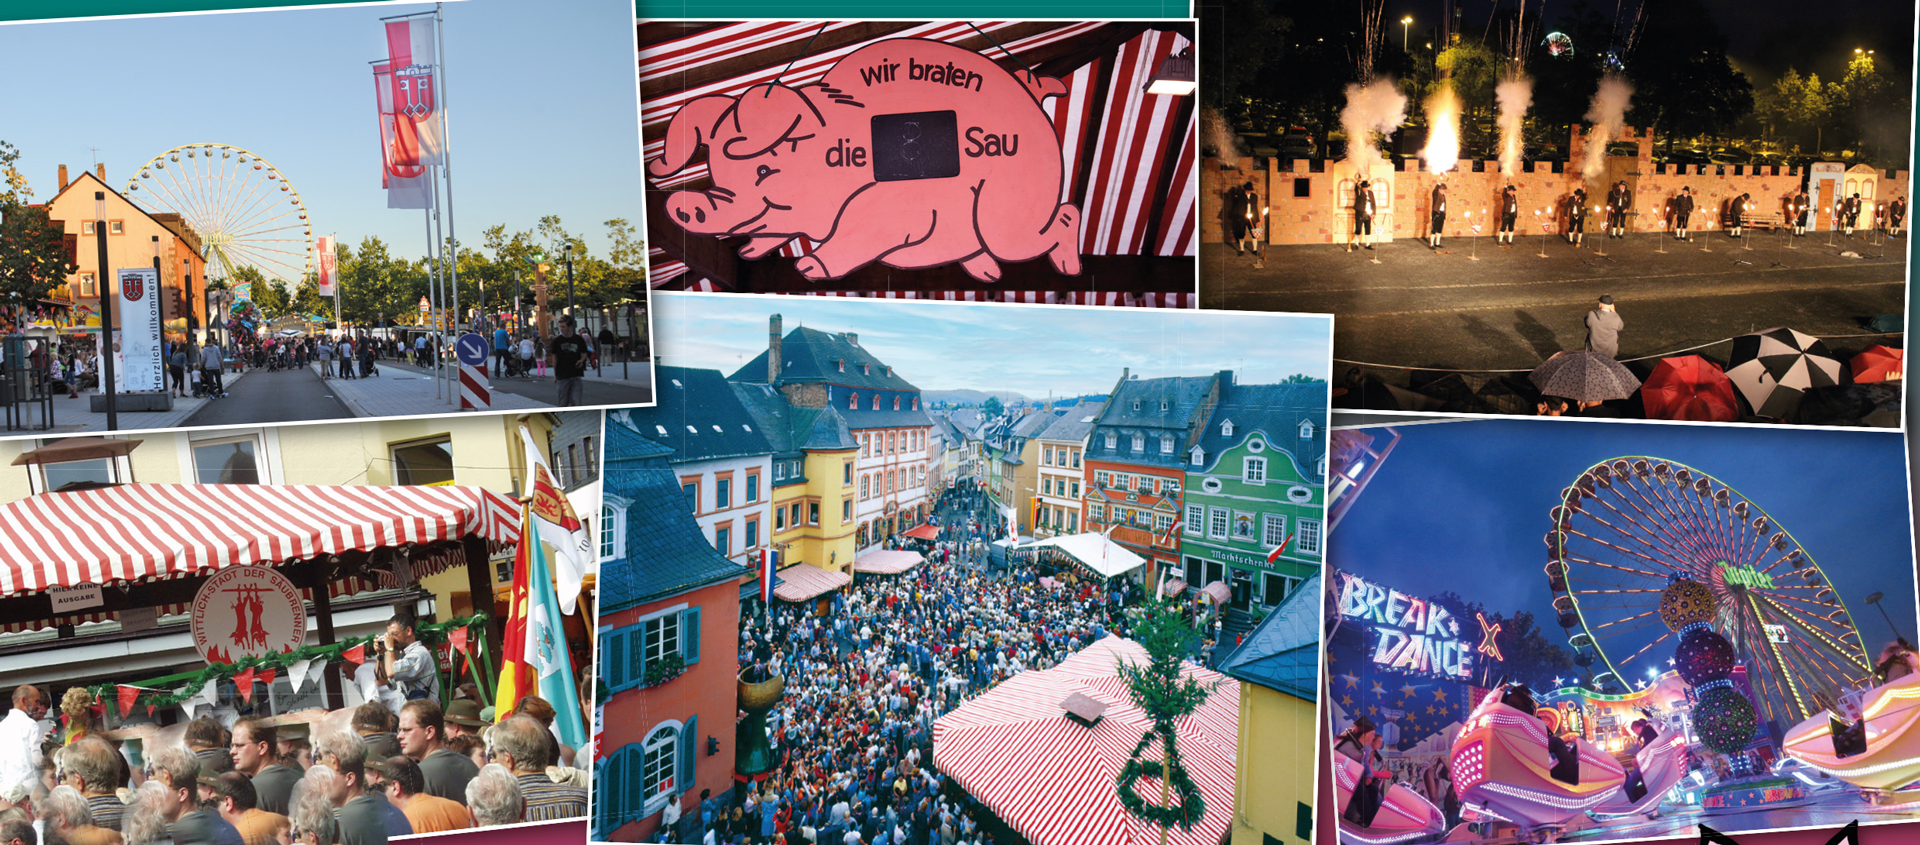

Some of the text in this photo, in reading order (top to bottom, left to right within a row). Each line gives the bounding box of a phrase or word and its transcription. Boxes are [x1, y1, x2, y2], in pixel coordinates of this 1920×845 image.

[859, 57, 984, 92] wir braten
[825, 126, 1019, 168] die Sau
[146, 274, 162, 390] Herzlich willkommen!
[52, 583, 99, 594] HIER KEINE
[1717, 560, 1777, 591] Jupiter
[57, 593, 96, 604] AUSGABE
[195, 570, 238, 646] WITTLICH-STADT
[244, 568, 266, 580] DER
[1338, 571, 1451, 638] BREAK
[1372, 626, 1473, 677] DANCE
